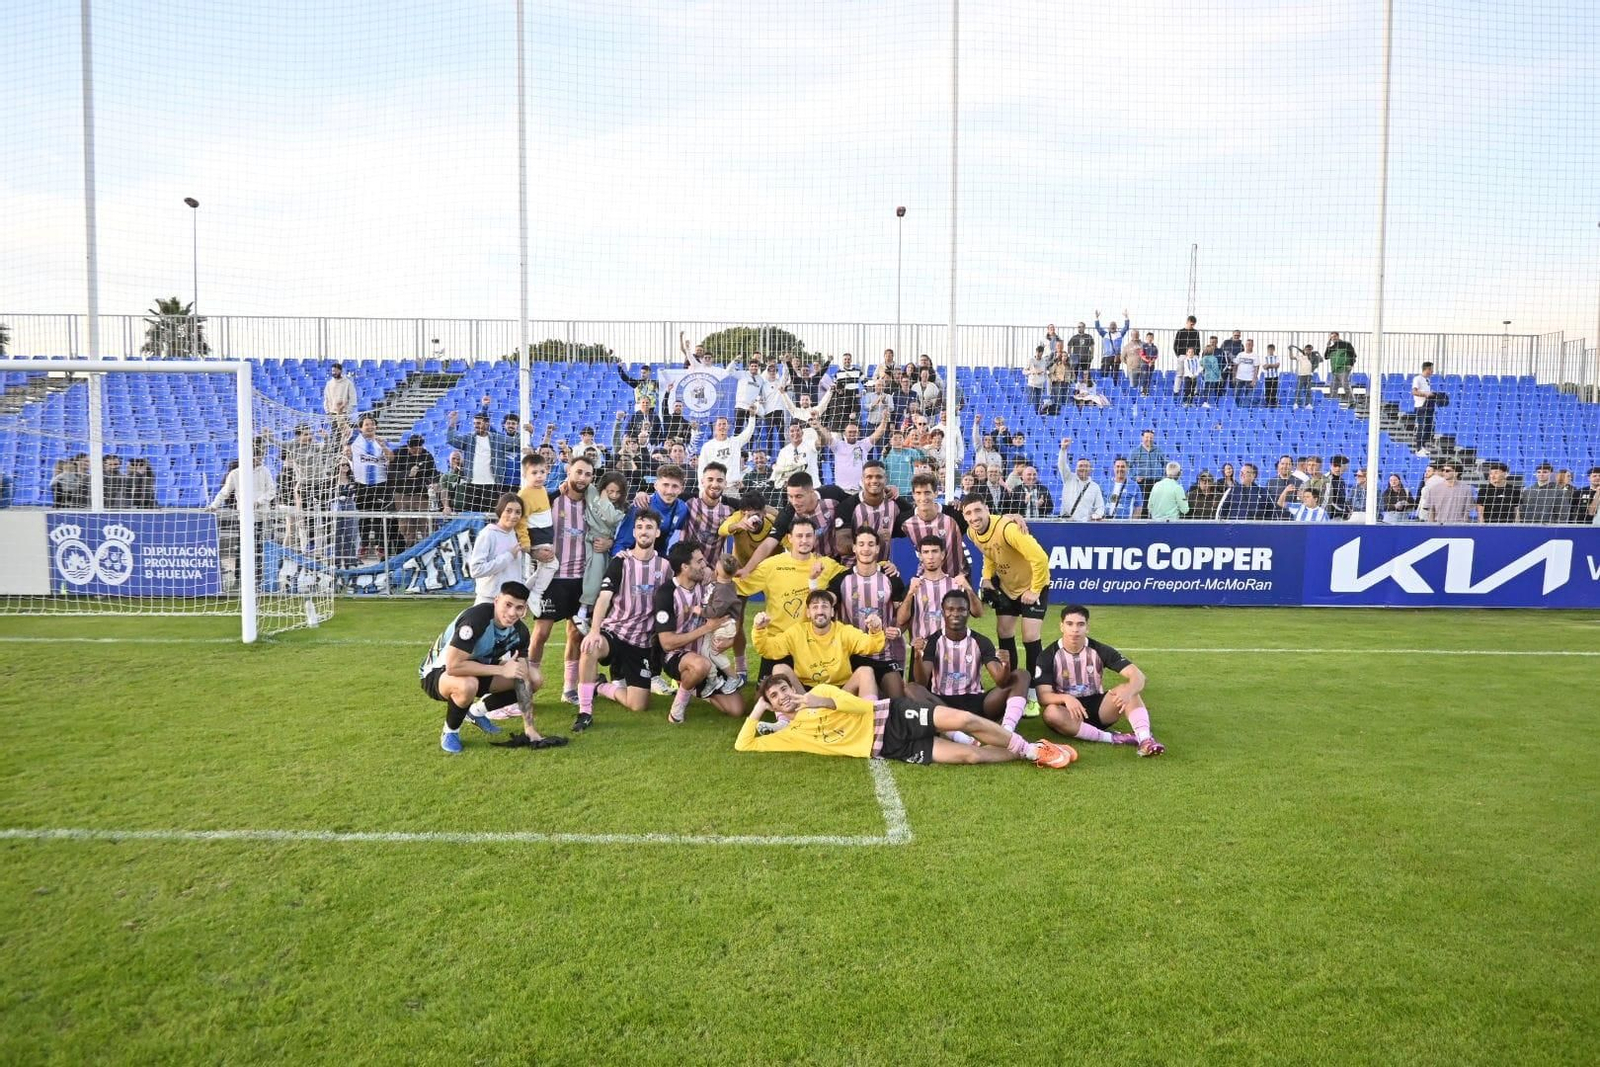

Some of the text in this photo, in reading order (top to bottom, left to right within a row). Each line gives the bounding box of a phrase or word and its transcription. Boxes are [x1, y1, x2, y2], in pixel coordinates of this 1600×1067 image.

[143, 545, 217, 556] DIPUTACIÓN
[144, 558, 216, 568] PROVINCIAL
[1048, 546, 1143, 570] ANTIC
[1330, 536, 1573, 596] KIA
[157, 569, 203, 579] HUELVA
[1048, 577, 1273, 593] añía del grupo Freeport-McMoRan
